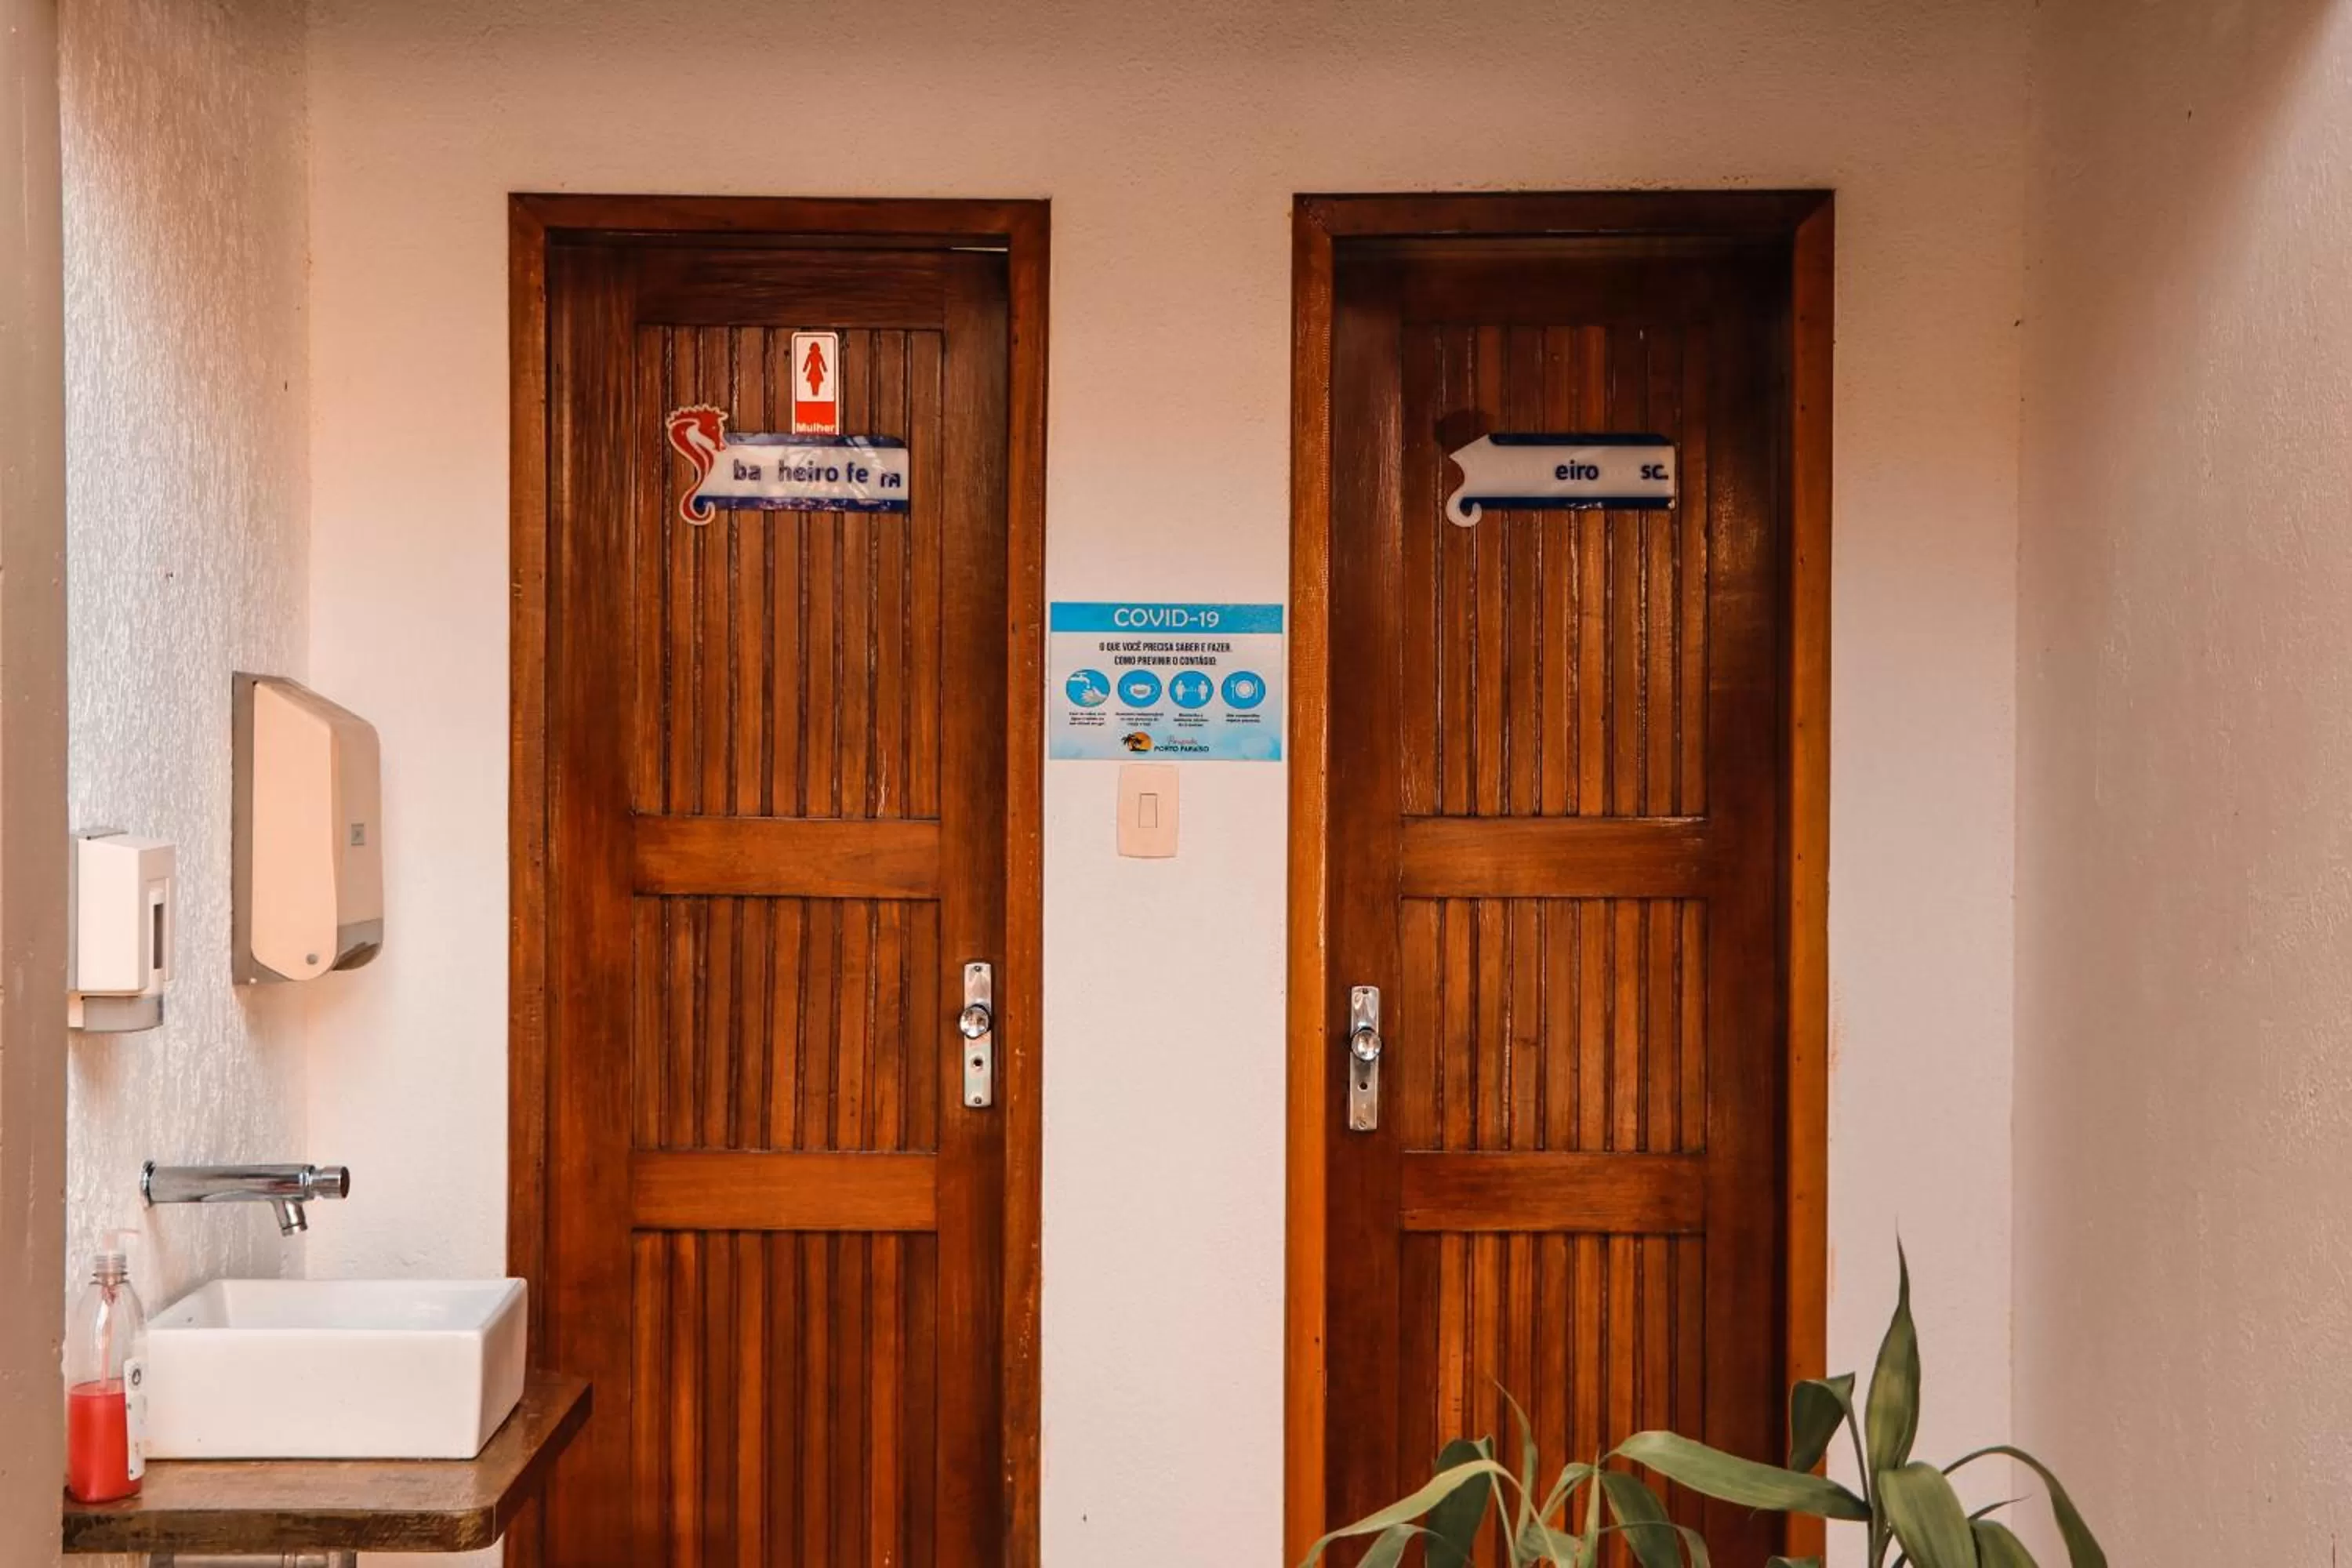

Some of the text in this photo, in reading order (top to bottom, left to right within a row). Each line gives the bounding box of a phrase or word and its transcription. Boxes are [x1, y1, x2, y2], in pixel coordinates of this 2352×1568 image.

[796, 423, 835, 433] Mulher
[1114, 608, 1220, 627] COVID-19
[1099, 642, 1105, 651] O
[1106, 642, 1120, 652] QUE
[1123, 640, 1142, 652] VOCÊ
[1143, 642, 1173, 652] PRECISA
[1175, 642, 1200, 652] SABER
[1201, 643, 1206, 652] E
[1114, 655, 1136, 666] COMO
[1172, 656, 1178, 666] O
